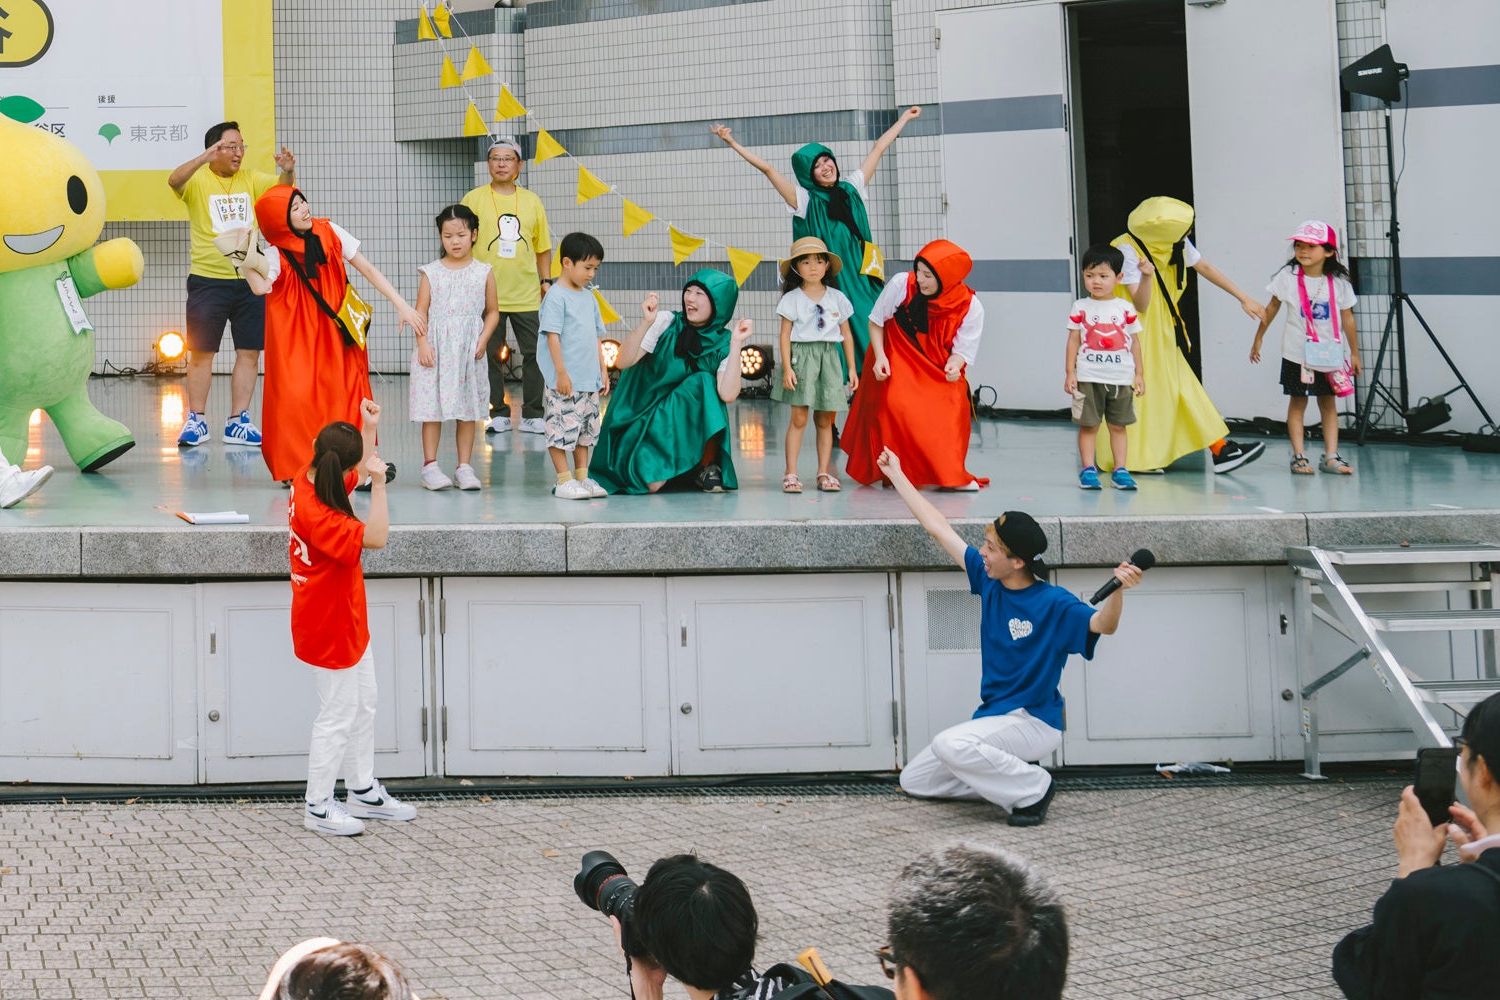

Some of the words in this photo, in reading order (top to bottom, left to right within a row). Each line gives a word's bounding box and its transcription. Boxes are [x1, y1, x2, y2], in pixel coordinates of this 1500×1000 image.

[1357, 67, 1383, 77] SHURE
[130, 124, 189, 142] 東京都
[216, 196, 245, 206] TOKYO
[864, 248, 885, 276] A
[1085, 353, 1122, 363] CRAB
